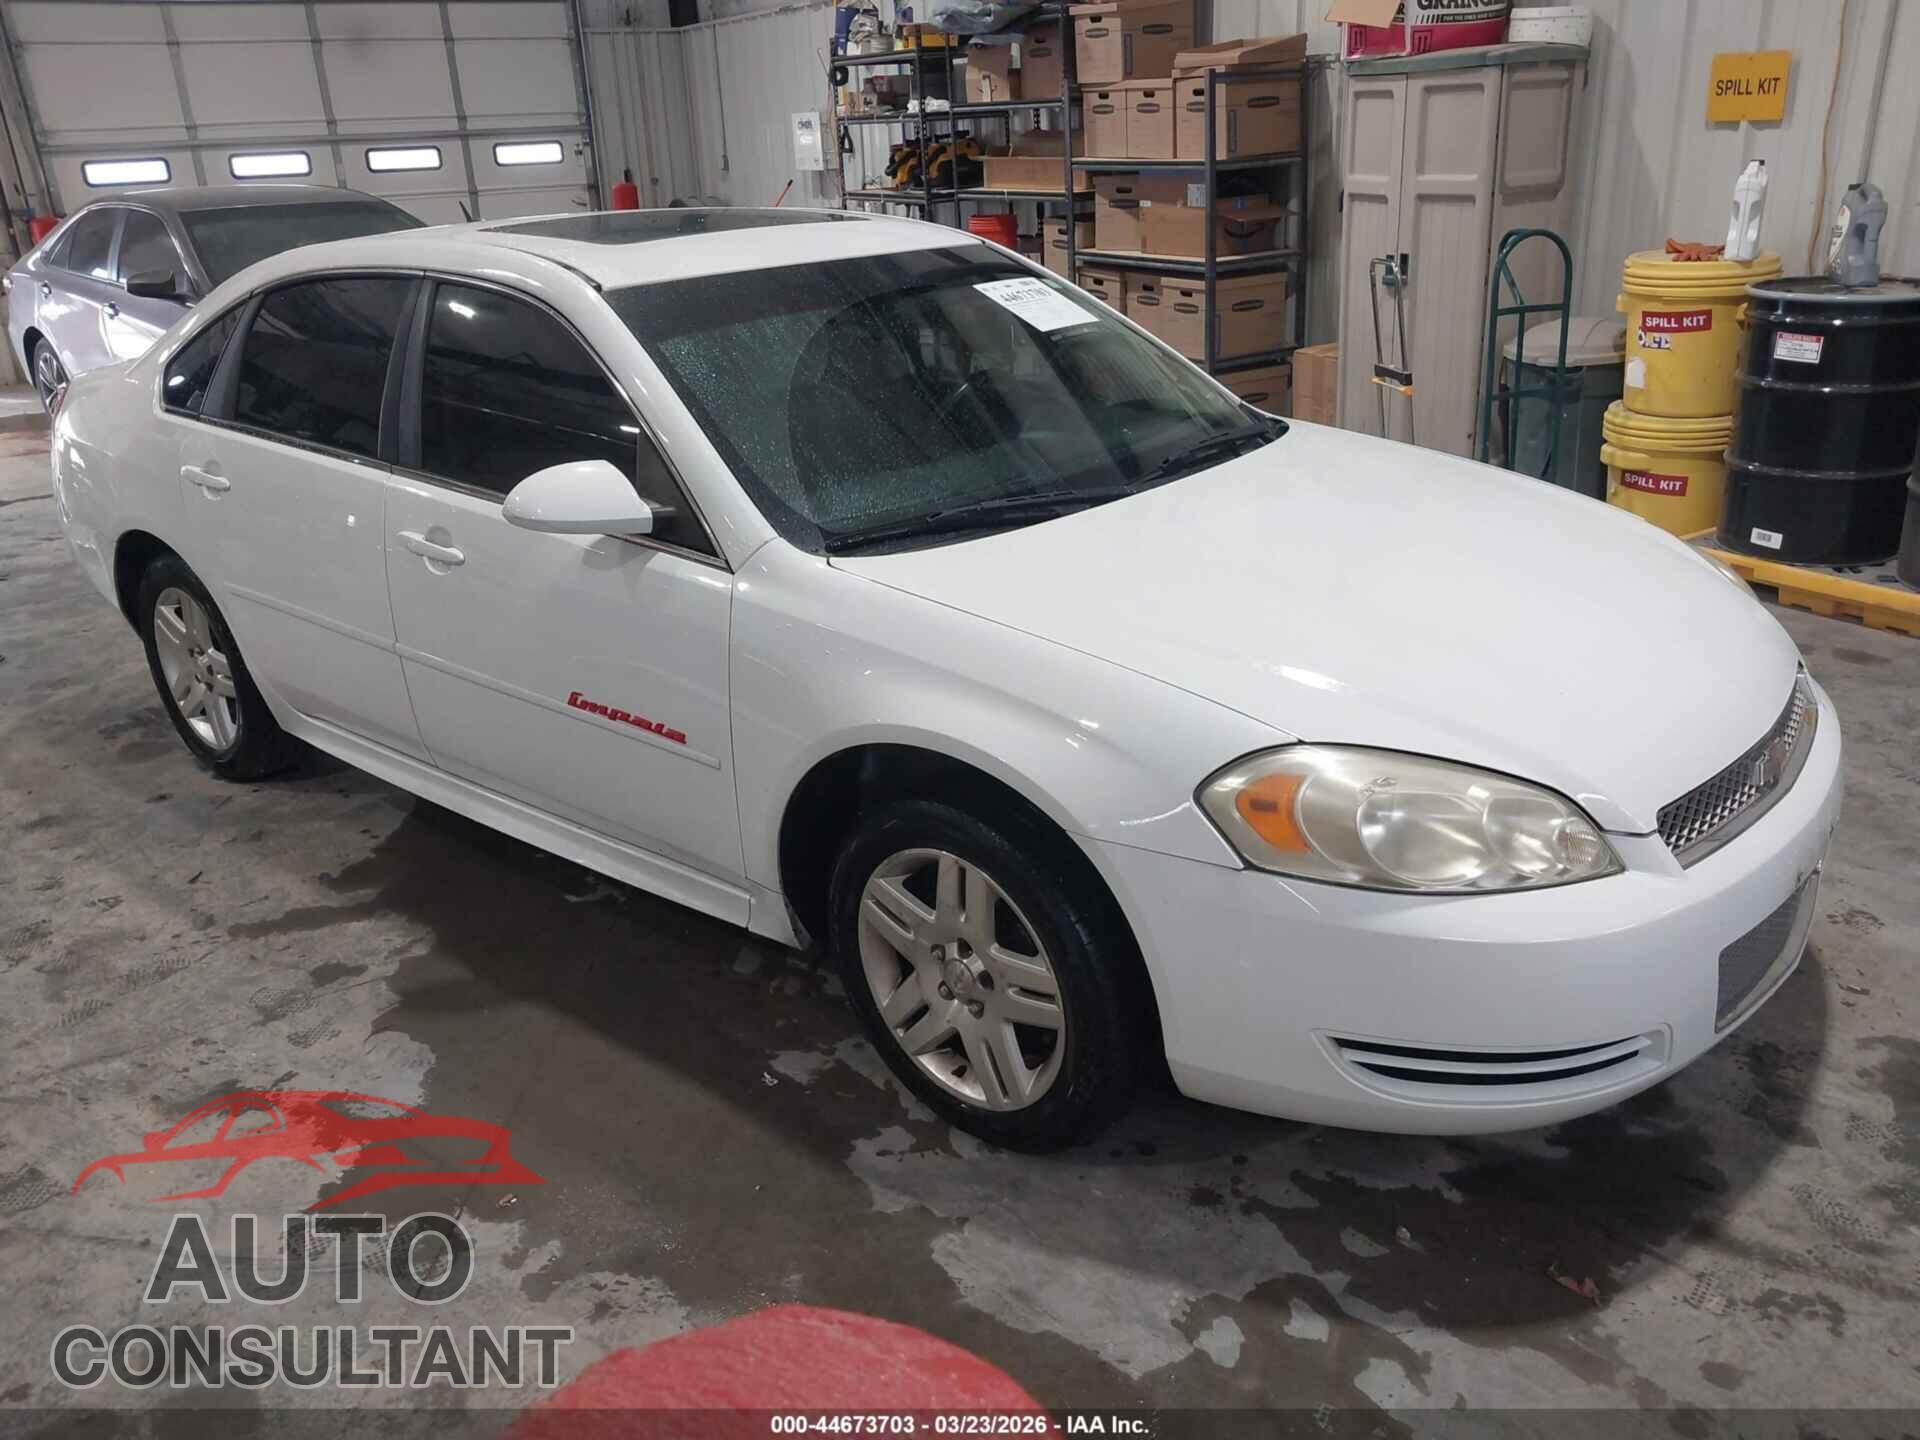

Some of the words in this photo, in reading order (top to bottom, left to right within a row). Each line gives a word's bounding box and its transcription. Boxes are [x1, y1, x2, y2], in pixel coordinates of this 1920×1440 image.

[1715, 78, 1752, 96] SPILL
[1757, 77, 1781, 96] KIT
[1645, 316, 1679, 328] SPILL
[1682, 315, 1707, 327] KIT
[1624, 472, 1656, 489] SPILL
[1659, 479, 1683, 491] KIT
